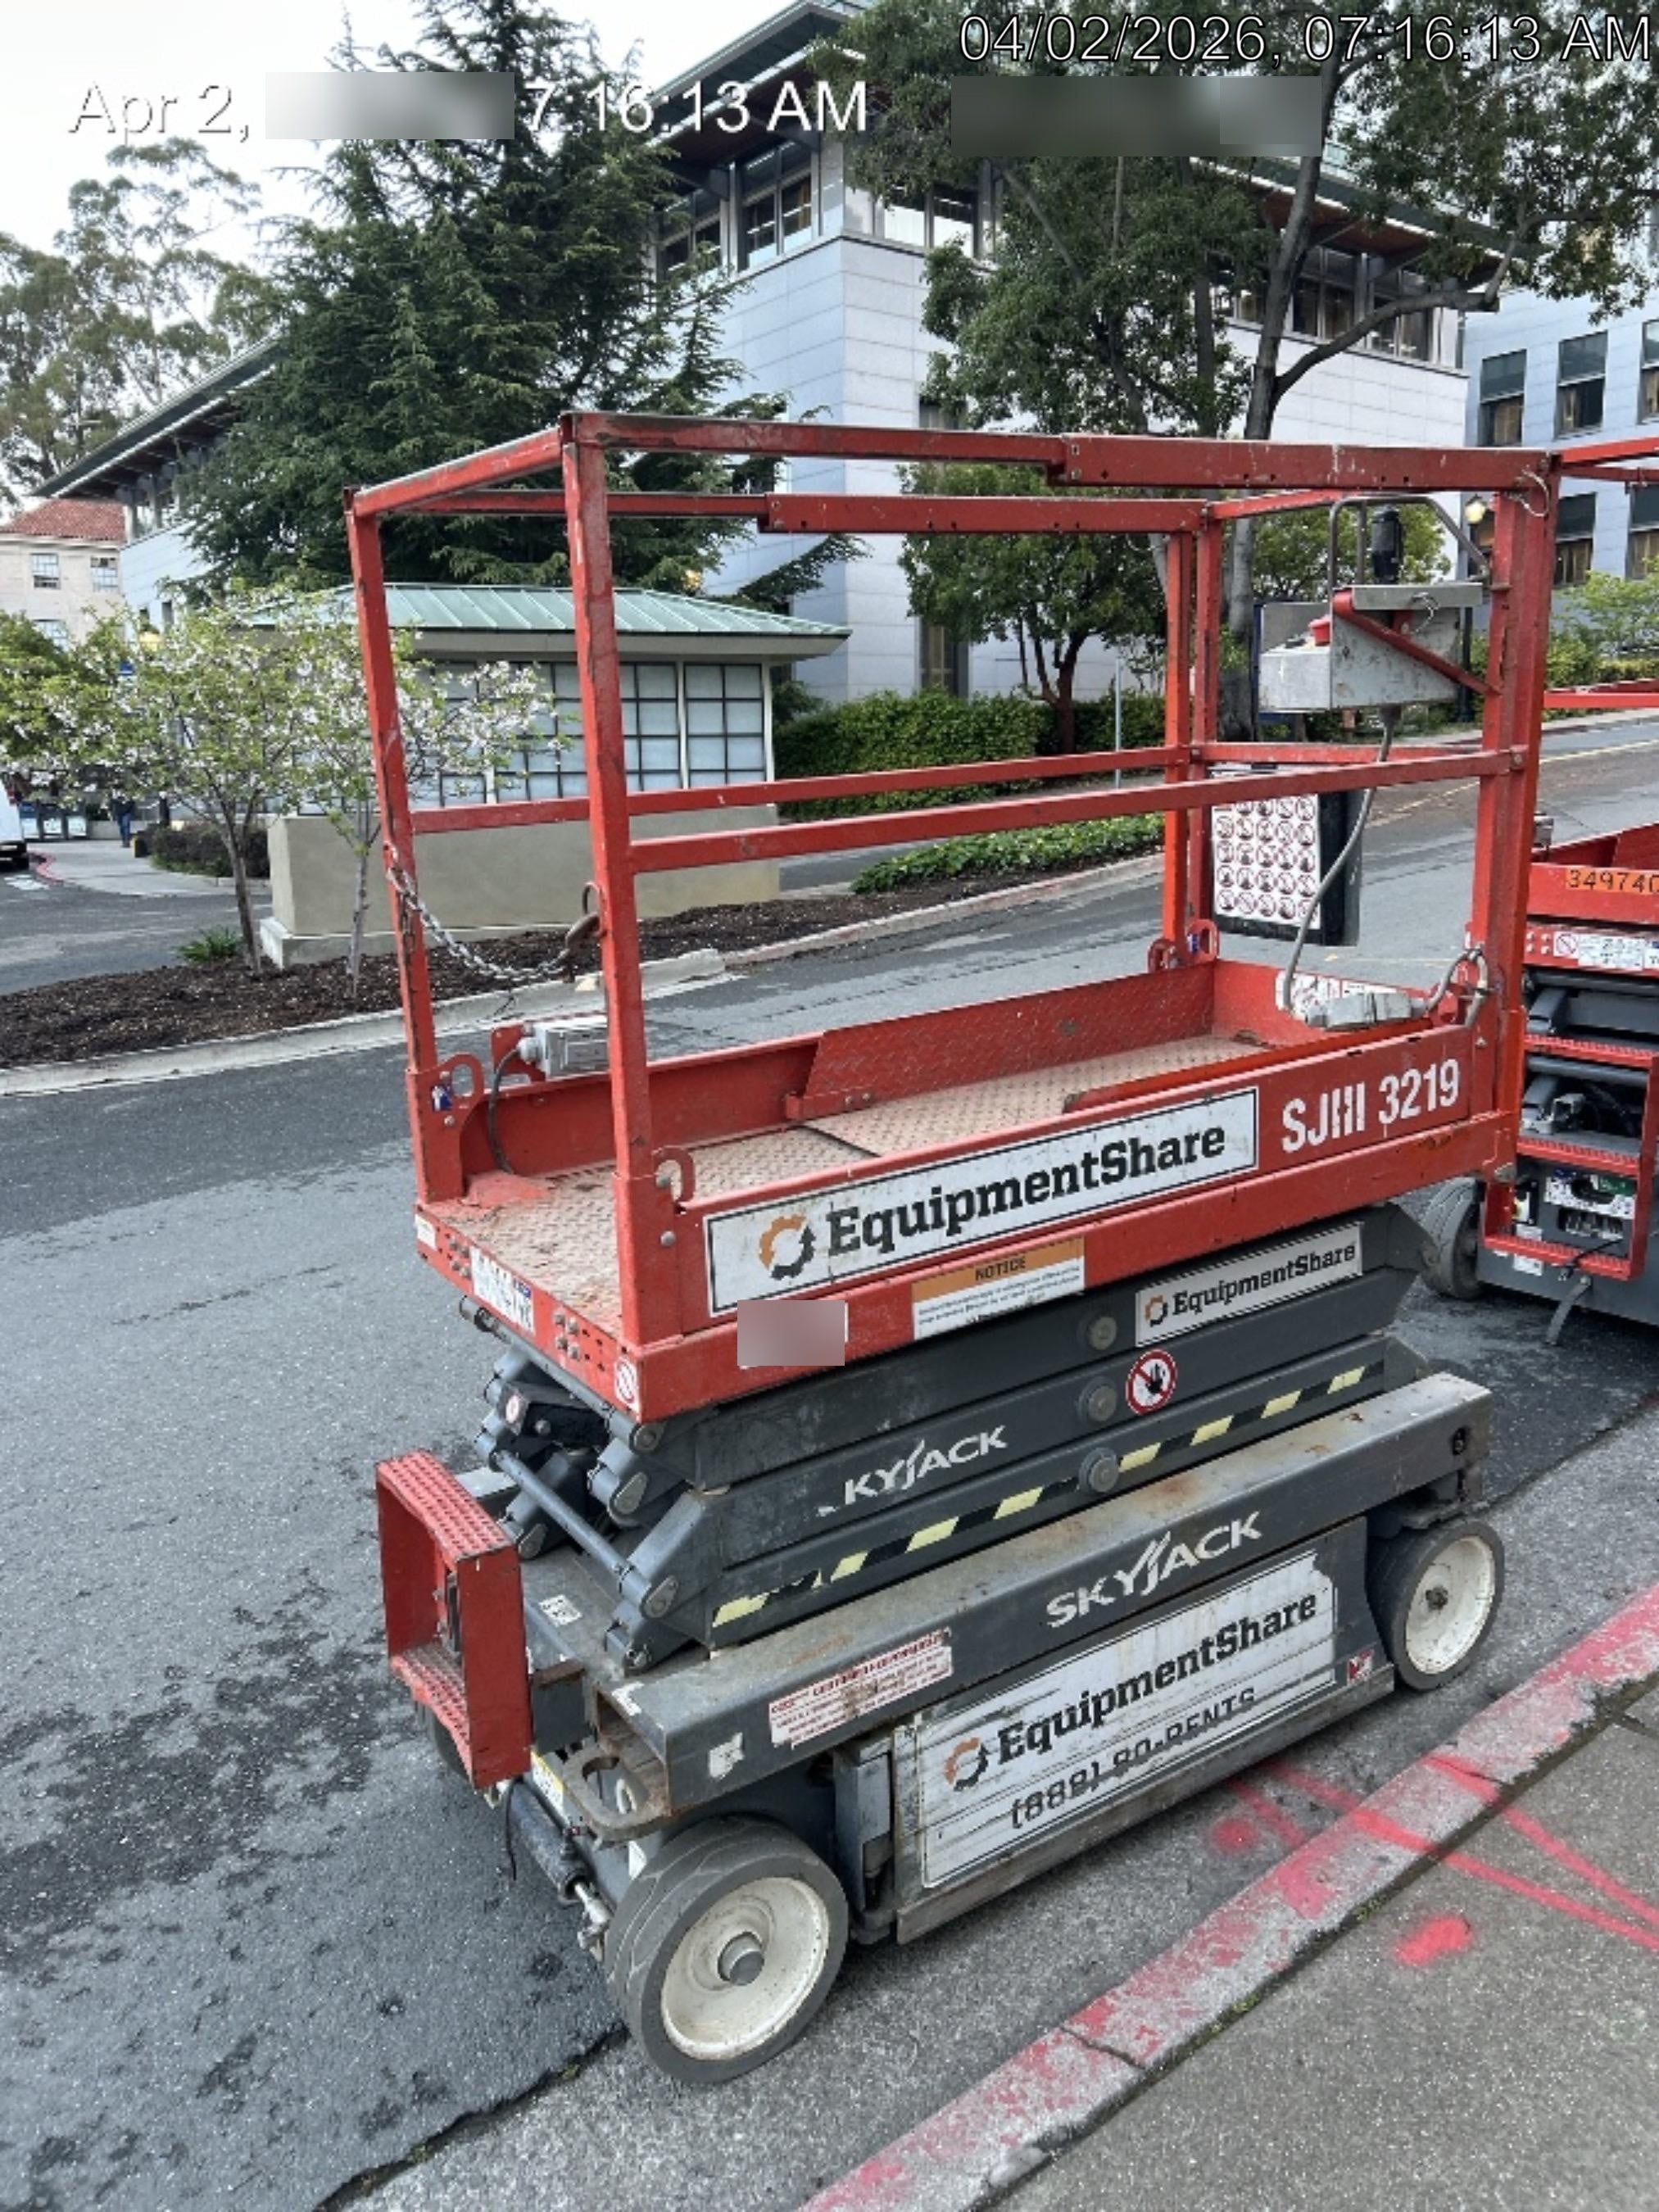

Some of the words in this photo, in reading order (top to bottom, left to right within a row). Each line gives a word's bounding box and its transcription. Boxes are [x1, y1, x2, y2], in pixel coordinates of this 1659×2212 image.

[1281, 1081, 1366, 1154] SJIII
[1378, 1058, 1459, 1124] 3219
[826, 1125, 1225, 1256] EquipmentShare
[975, 1255, 1027, 1281] NOTICE
[1172, 1243, 1356, 1315] EquipmentShare
[817, 1425, 1009, 1517] KYJACK
[1046, 1511, 1262, 1628] SKYJACK
[998, 1593, 1317, 1763] EquipmentShare
